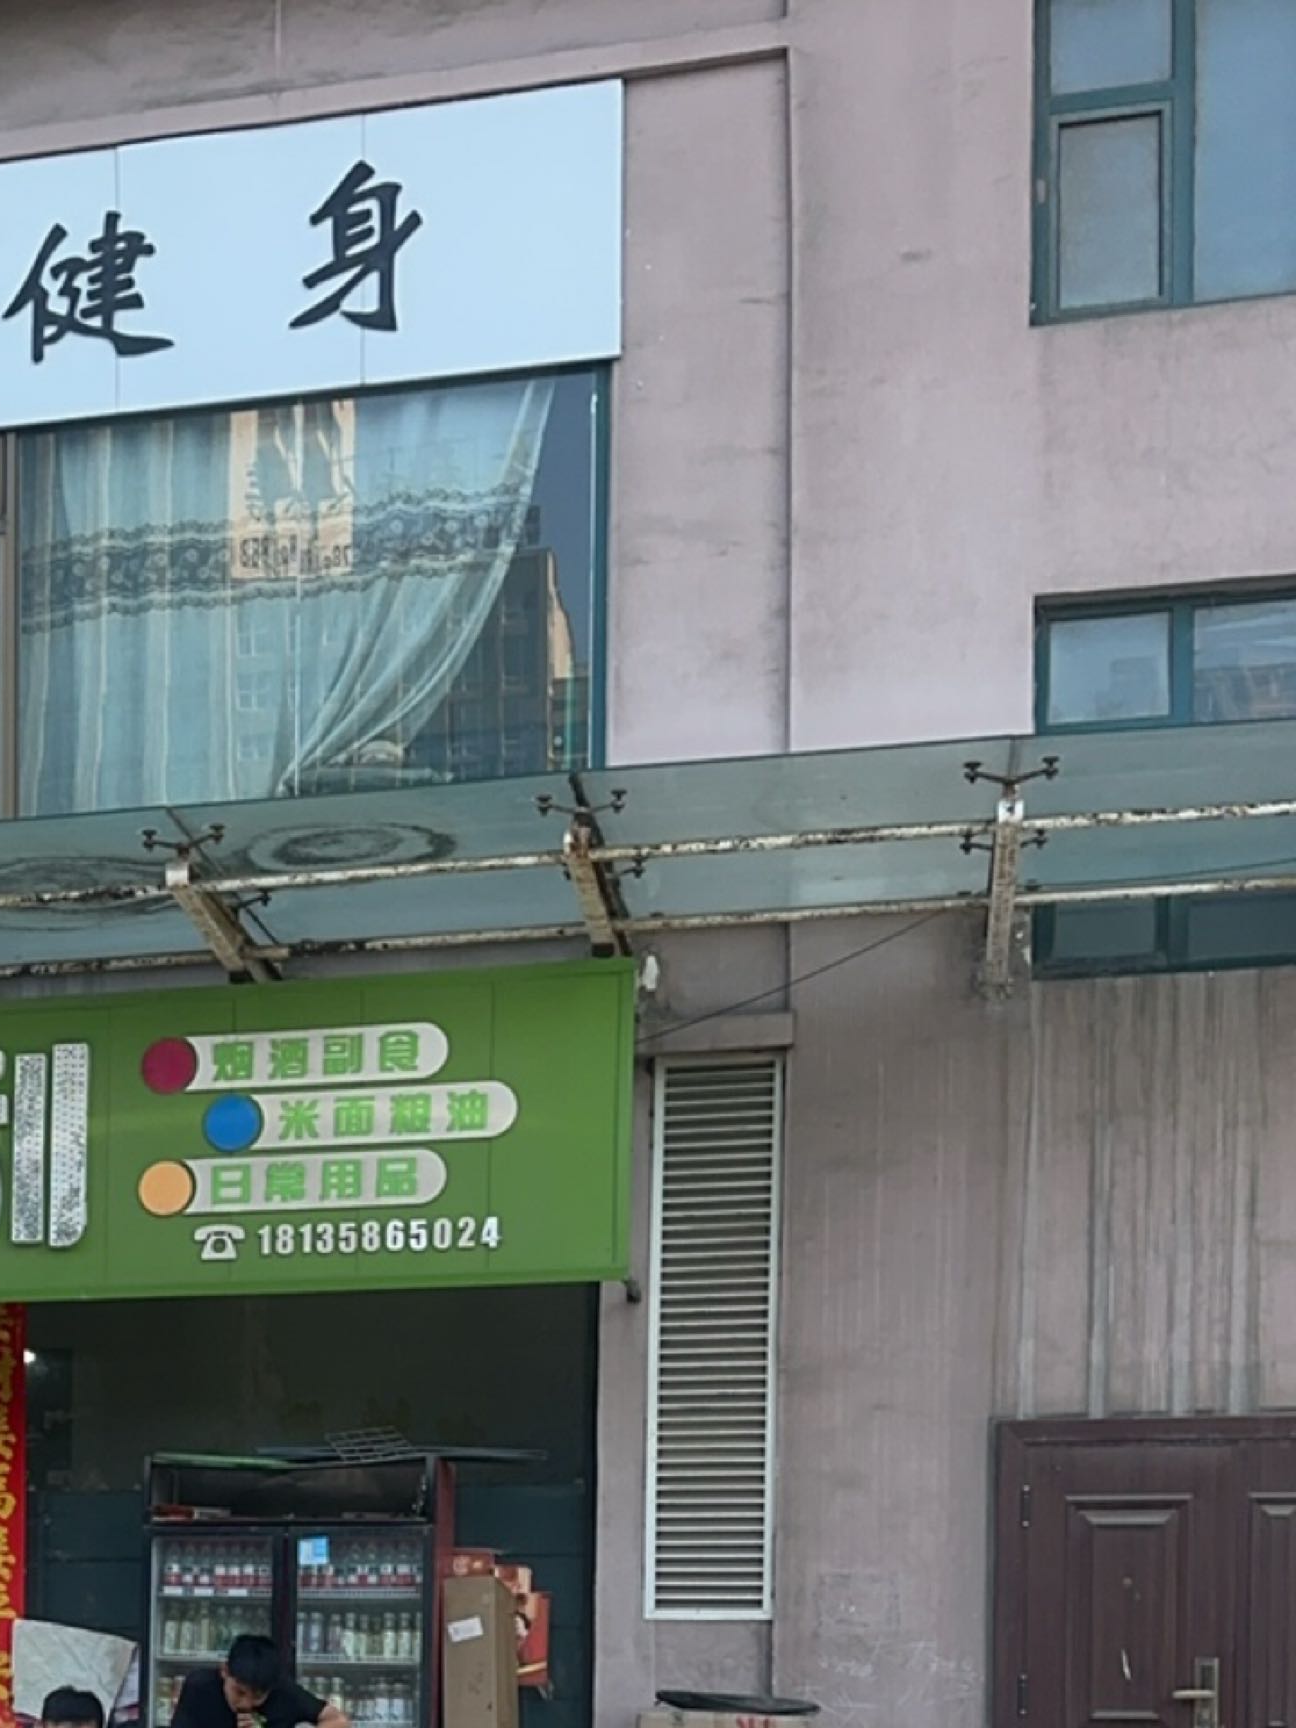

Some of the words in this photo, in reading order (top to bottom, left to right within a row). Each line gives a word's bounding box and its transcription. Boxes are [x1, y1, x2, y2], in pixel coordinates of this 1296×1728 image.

[211, 1030, 420, 1081] 烟酒副食
[278, 1089, 489, 1140] 米面粮油
[210, 1156, 418, 1205] 日常用品
[257, 1216, 501, 1256] 18135865024
